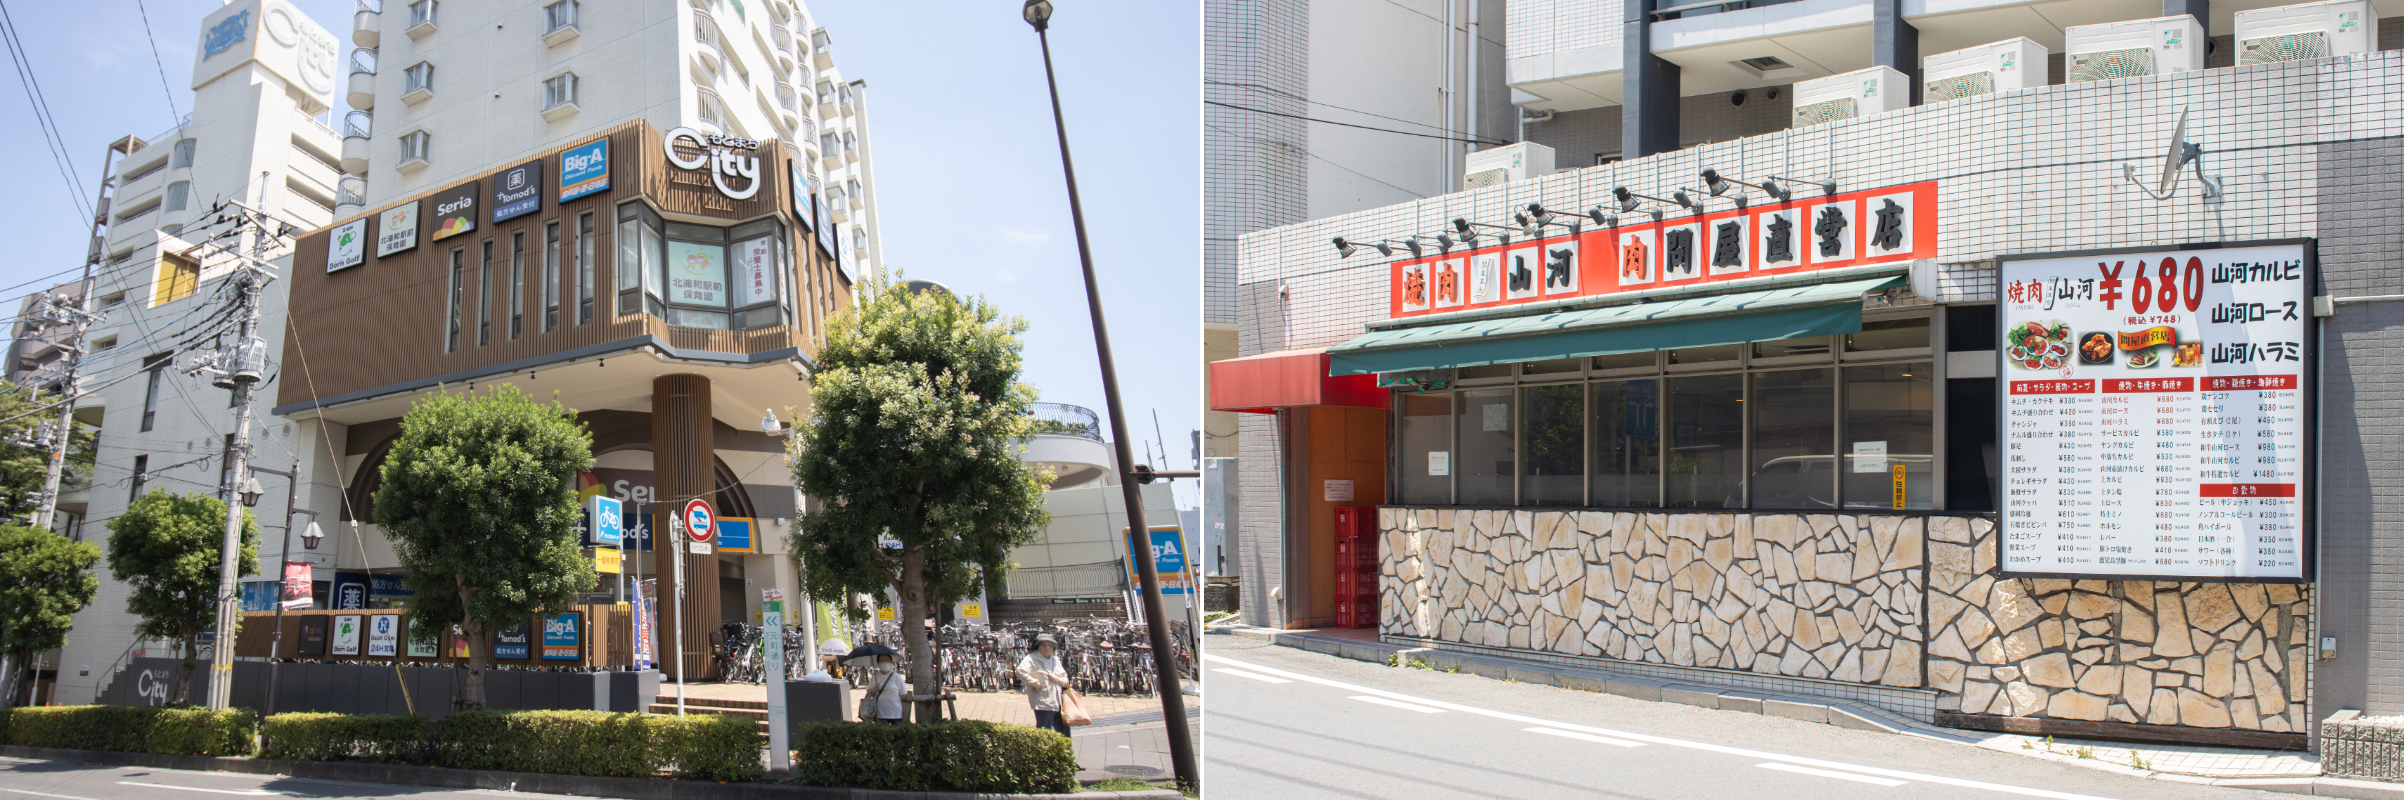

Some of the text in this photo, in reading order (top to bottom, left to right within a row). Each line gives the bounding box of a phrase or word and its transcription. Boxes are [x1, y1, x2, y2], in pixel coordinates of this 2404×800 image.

[709, 131, 758, 150] もとまち
[565, 148, 602, 174] Big-A
[664, 127, 760, 200] City
[510, 172, 522, 187] 薬
[503, 185, 535, 203] Tomod's
[438, 196, 472, 216] Seria
[496, 200, 535, 218] 処方せん受付
[380, 228, 414, 245] 北浦和駅前
[386, 239, 407, 252] 保育園
[346, 254, 360, 265] Golf
[1403, 261, 1459, 307] 焼肉
[1509, 248, 1574, 293] 山河
[2211, 259, 2301, 284] 山河カルビ
[673, 278, 722, 292] 北浦和駅前
[2007, 278, 2095, 304] 焼肉 山河
[2098, 256, 2205, 315] ¥680
[684, 289, 713, 301] 保育園
[2211, 301, 2299, 324] 山河ロース
[2120, 330, 2170, 347] 問屋直営店
[2211, 341, 2300, 364] 山河ハラミ
[546, 619, 575, 635] Big-A
[501, 634, 526, 643] Tomod's
[770, 632, 779, 671] 元町通り
[138, 669, 168, 707] City
